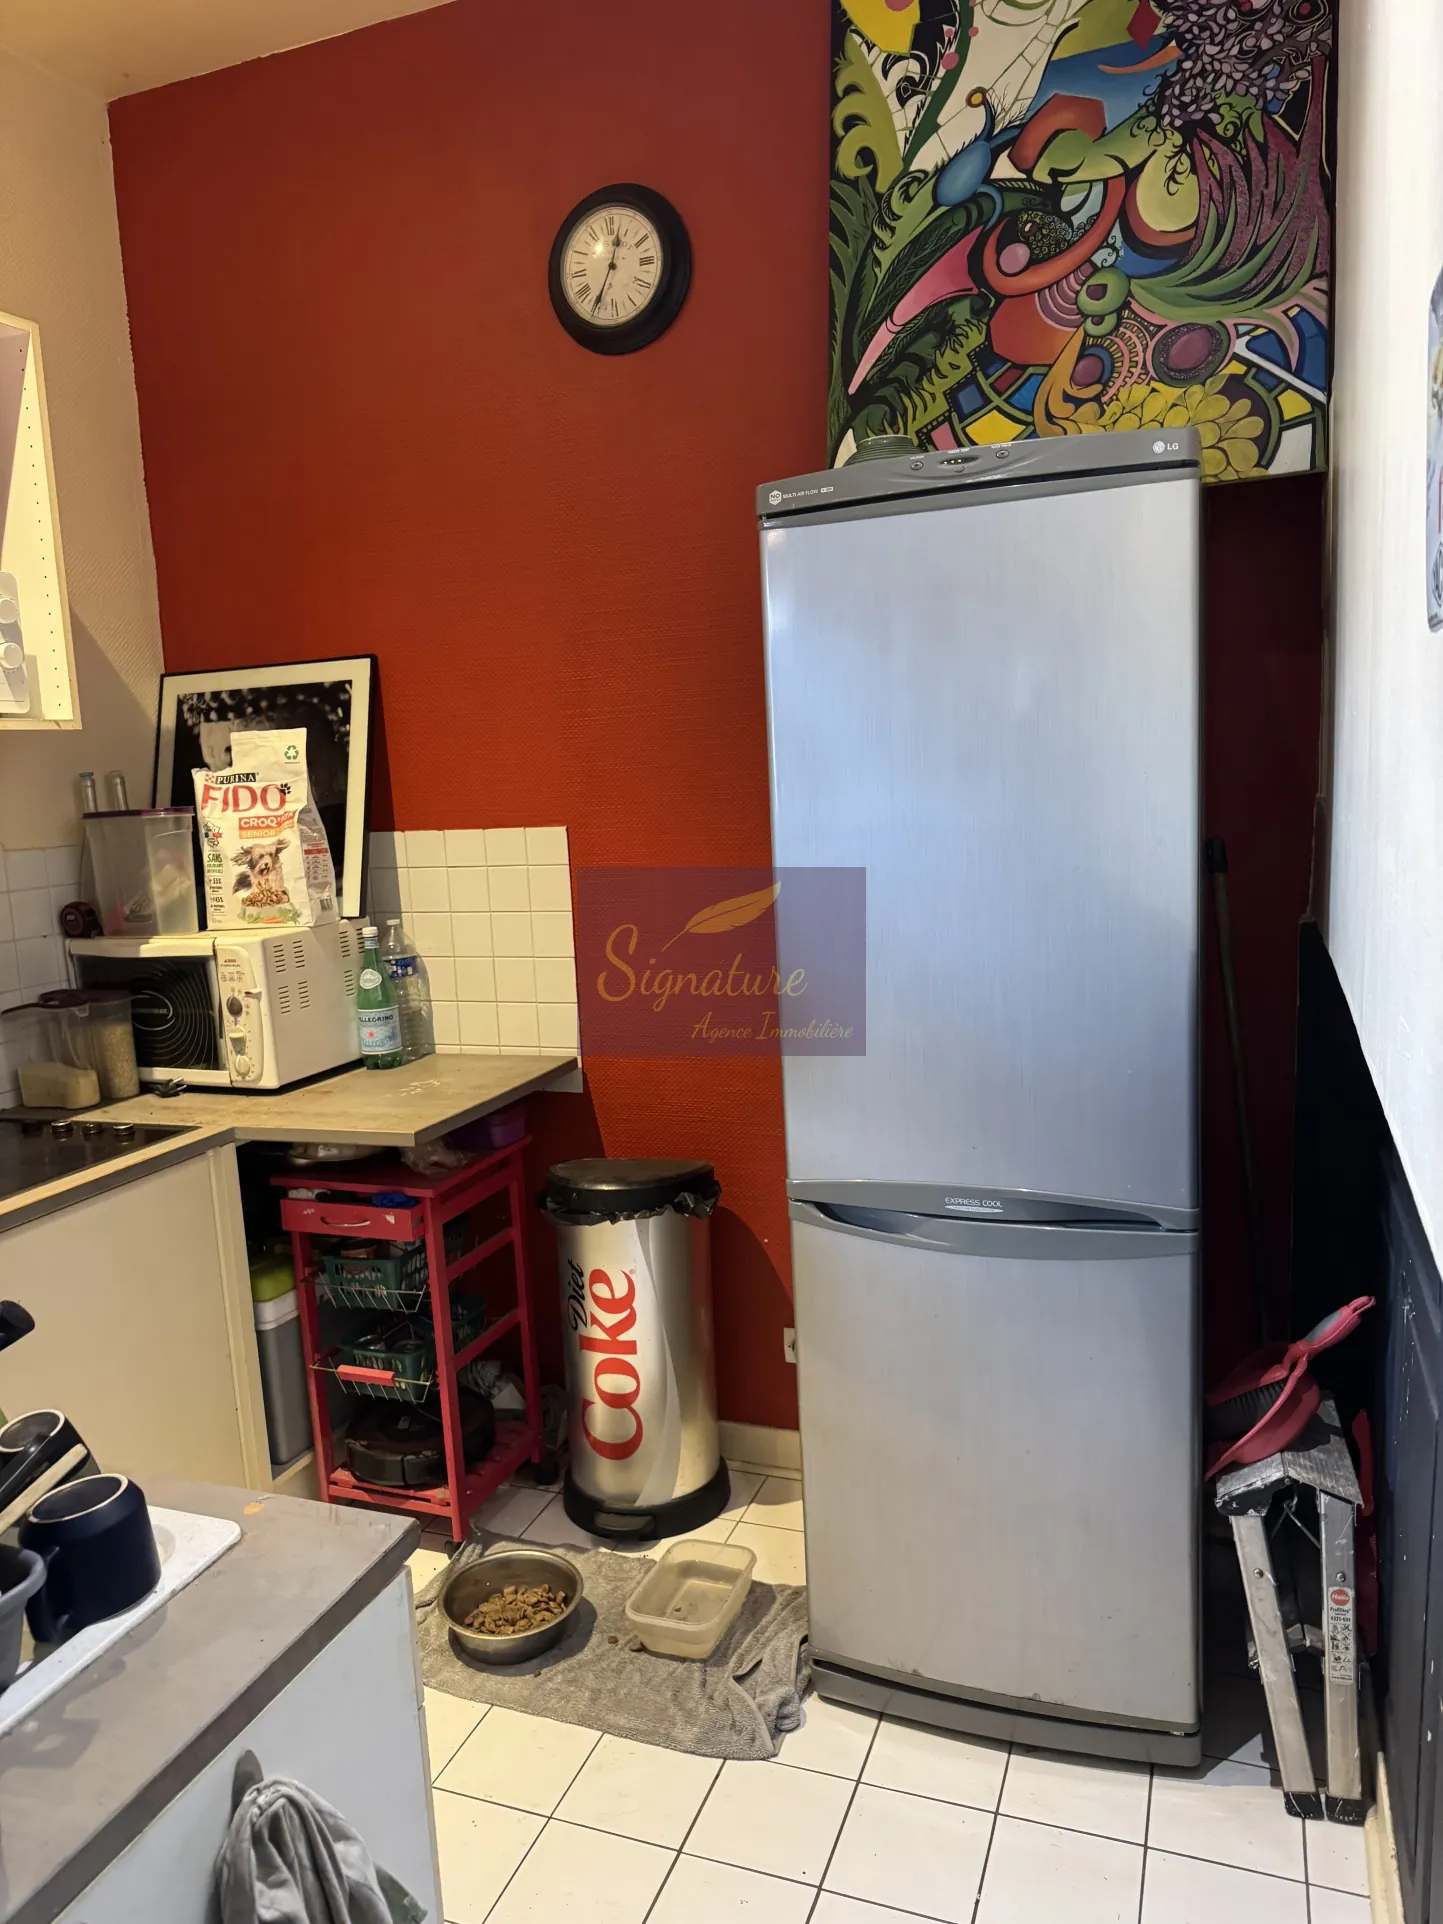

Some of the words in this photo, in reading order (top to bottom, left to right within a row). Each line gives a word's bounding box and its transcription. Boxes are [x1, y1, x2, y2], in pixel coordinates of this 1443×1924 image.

[1167, 442, 1179, 450] LG
[216, 773, 255, 784] PURINA
[201, 783, 287, 813] FIDO
[944, 1197, 981, 1206] EXPRESS
[982, 1199, 1003, 1208] COOL
[567, 1258, 588, 1331] Diet
[579, 1268, 643, 1461] Coke
